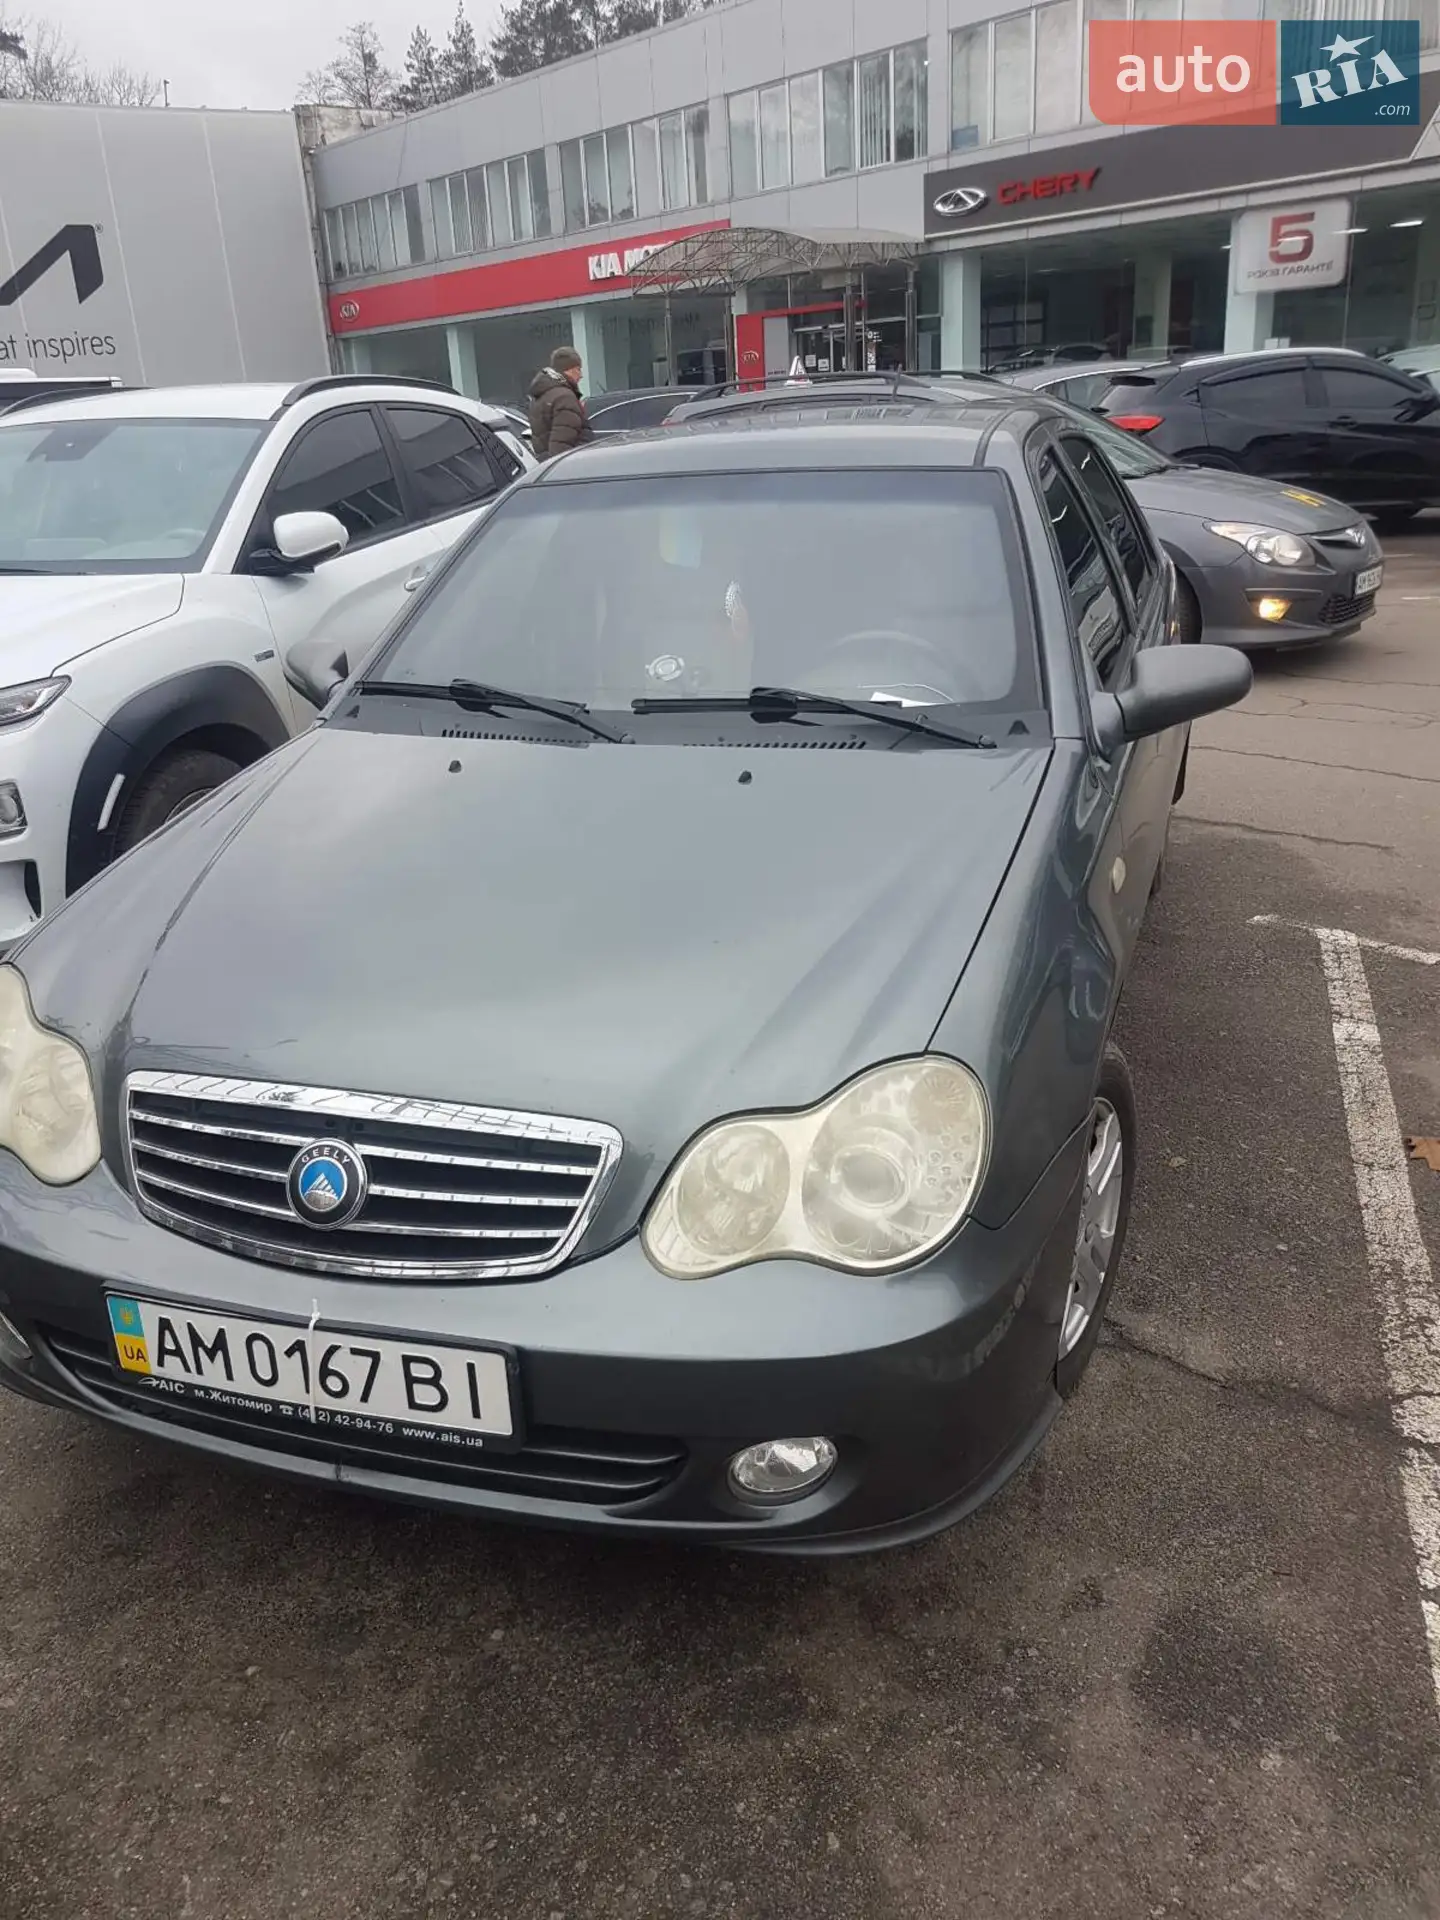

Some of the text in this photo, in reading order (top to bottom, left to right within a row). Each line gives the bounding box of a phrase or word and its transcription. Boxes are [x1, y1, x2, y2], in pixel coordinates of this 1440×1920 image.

[997, 166, 1102, 205] CHERY
[1268, 211, 1315, 264] 5
[588, 252, 623, 281] KIA
[25, 331, 116, 364] inspires
[301, 1147, 351, 1164] GEELY
[123, 1345, 147, 1362] UA
[157, 1316, 481, 1420] AM 0167 BI
[194, 1389, 273, 1413] м.Житомир
[298, 1406, 331, 1423] (42)
[334, 1414, 394, 1434] 42-94-76
[402, 1426, 483, 1447] www.ais.ua
